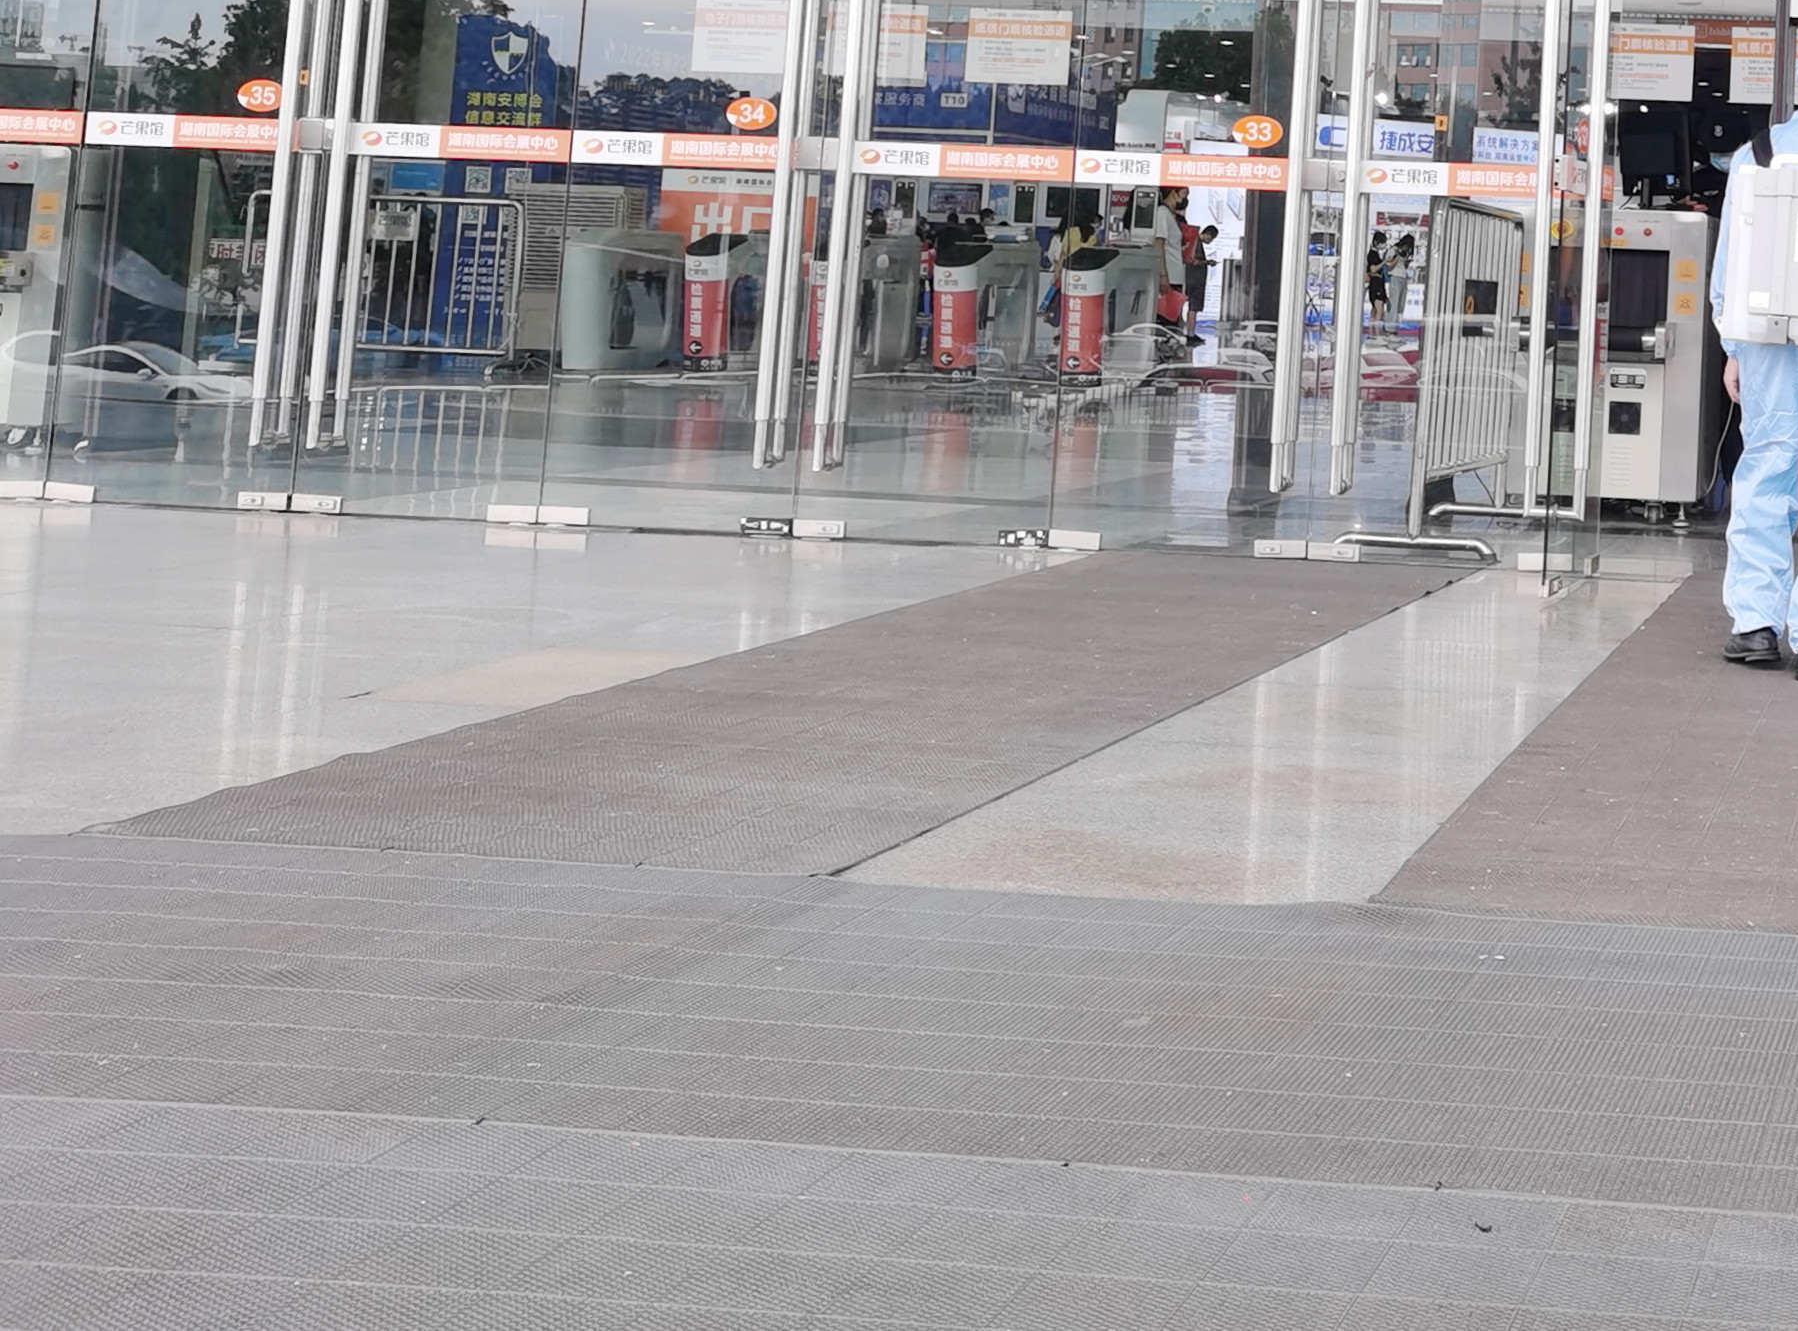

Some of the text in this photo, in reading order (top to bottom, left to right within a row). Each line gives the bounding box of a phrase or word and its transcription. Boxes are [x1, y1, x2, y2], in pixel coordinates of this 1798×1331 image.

[250, 86, 275, 105] 35
[943, 95, 965, 105] T10
[739, 103, 765, 122] 34
[120, 120, 280, 139] 芒果馆 湖南国际会展中
[1244, 121, 1272, 140] 33
[385, 131, 559, 150] 芒果馆 湖南国际会展中心
[607, 138, 653, 155] 芒果馆
[1380, 129, 1434, 153] 捷成安
[883, 150, 1059, 170] 芒果馆 湖南国际会展中心
[1103, 158, 1282, 179] 芒果馆 湖南国际会展中心
[1391, 168, 1438, 186] 芒果馆
